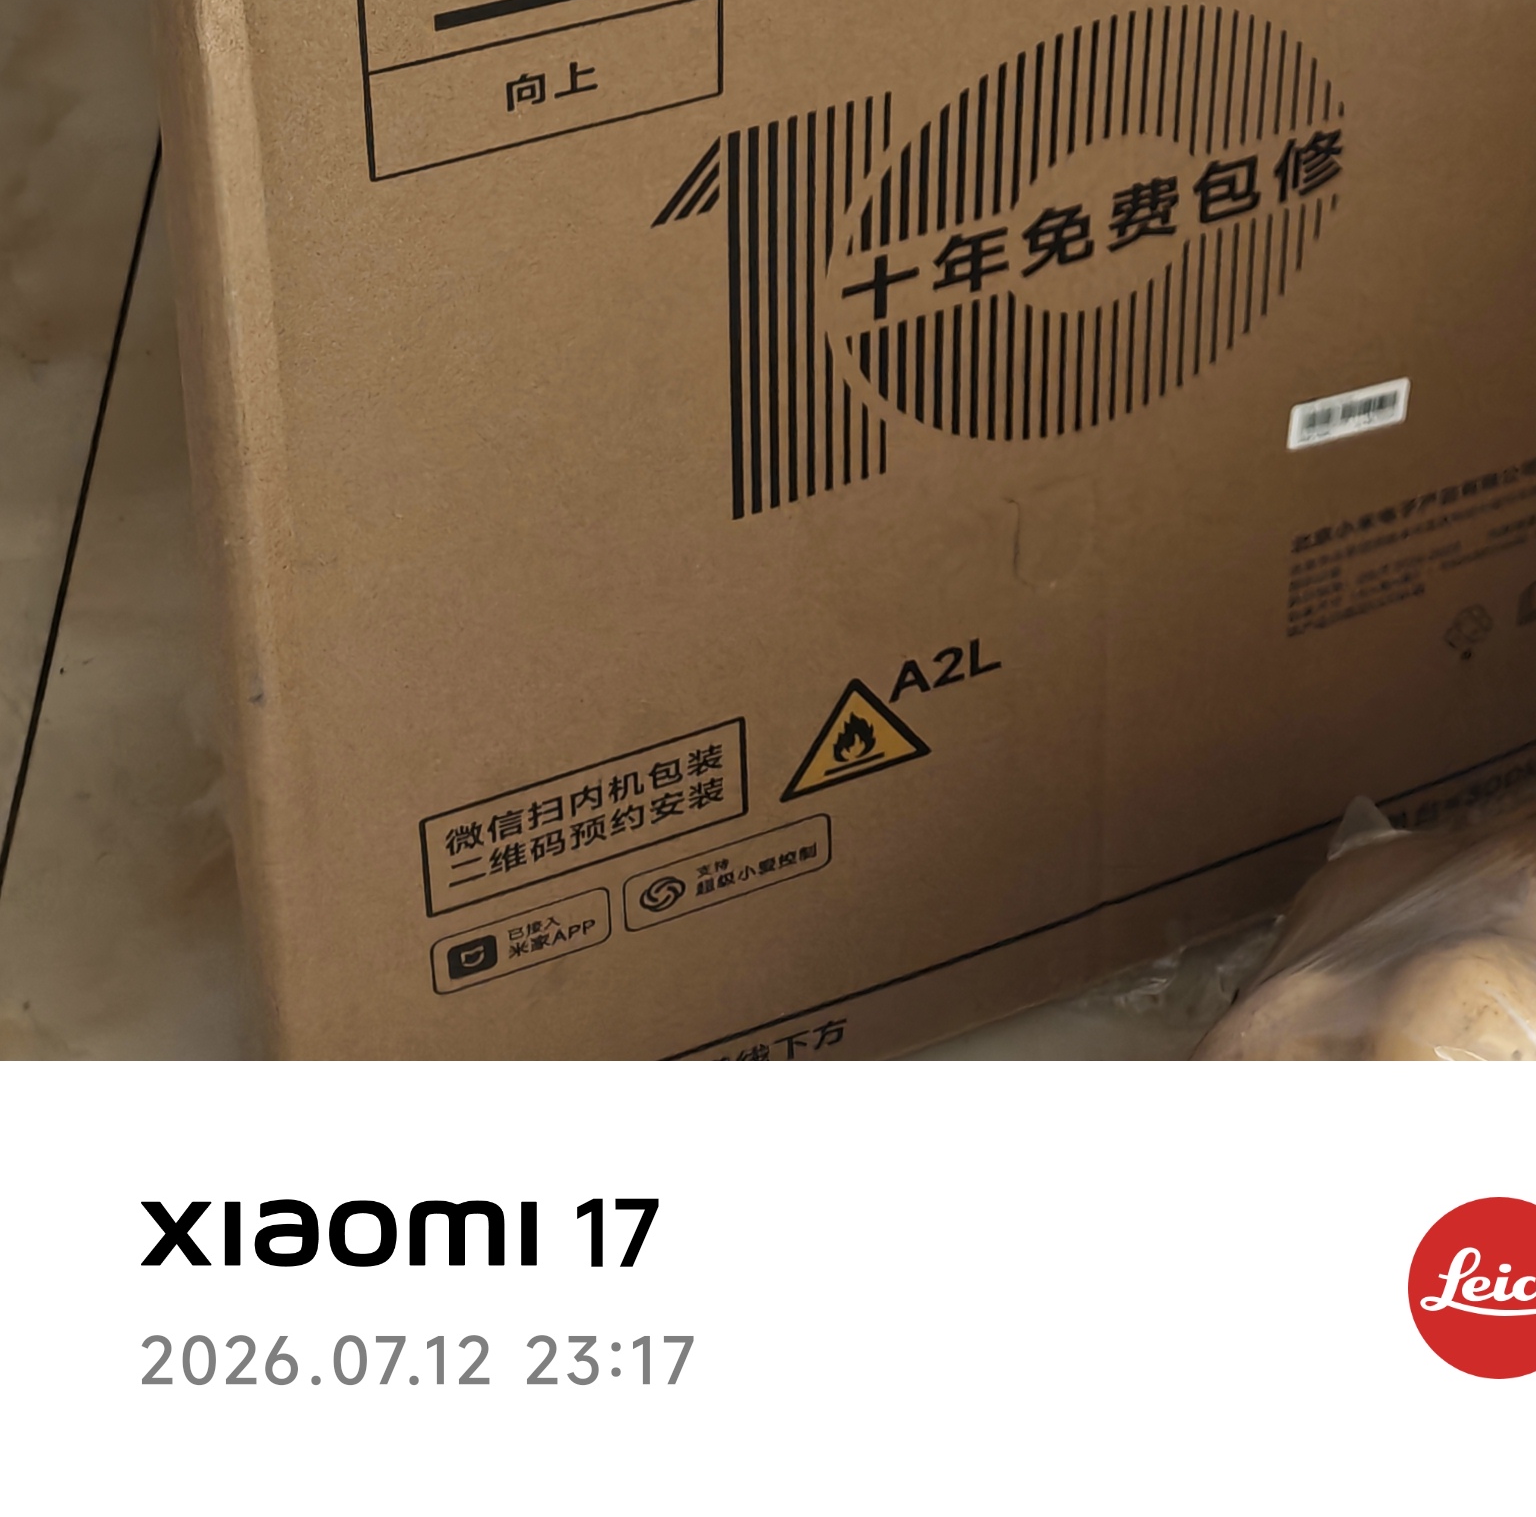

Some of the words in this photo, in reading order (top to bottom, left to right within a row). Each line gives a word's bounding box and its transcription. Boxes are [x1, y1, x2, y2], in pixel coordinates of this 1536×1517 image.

[505, 61, 599, 113] 向上
[841, 127, 1345, 321] 十年免费包修
[887, 638, 1003, 705] A2L
[444, 743, 725, 857] 微信扫内机包装
[448, 775, 726, 890] 二维码预约安装
[696, 858, 730, 877] 支持
[507, 915, 561, 941] 已接入
[508, 918, 596, 960] 米家APP
